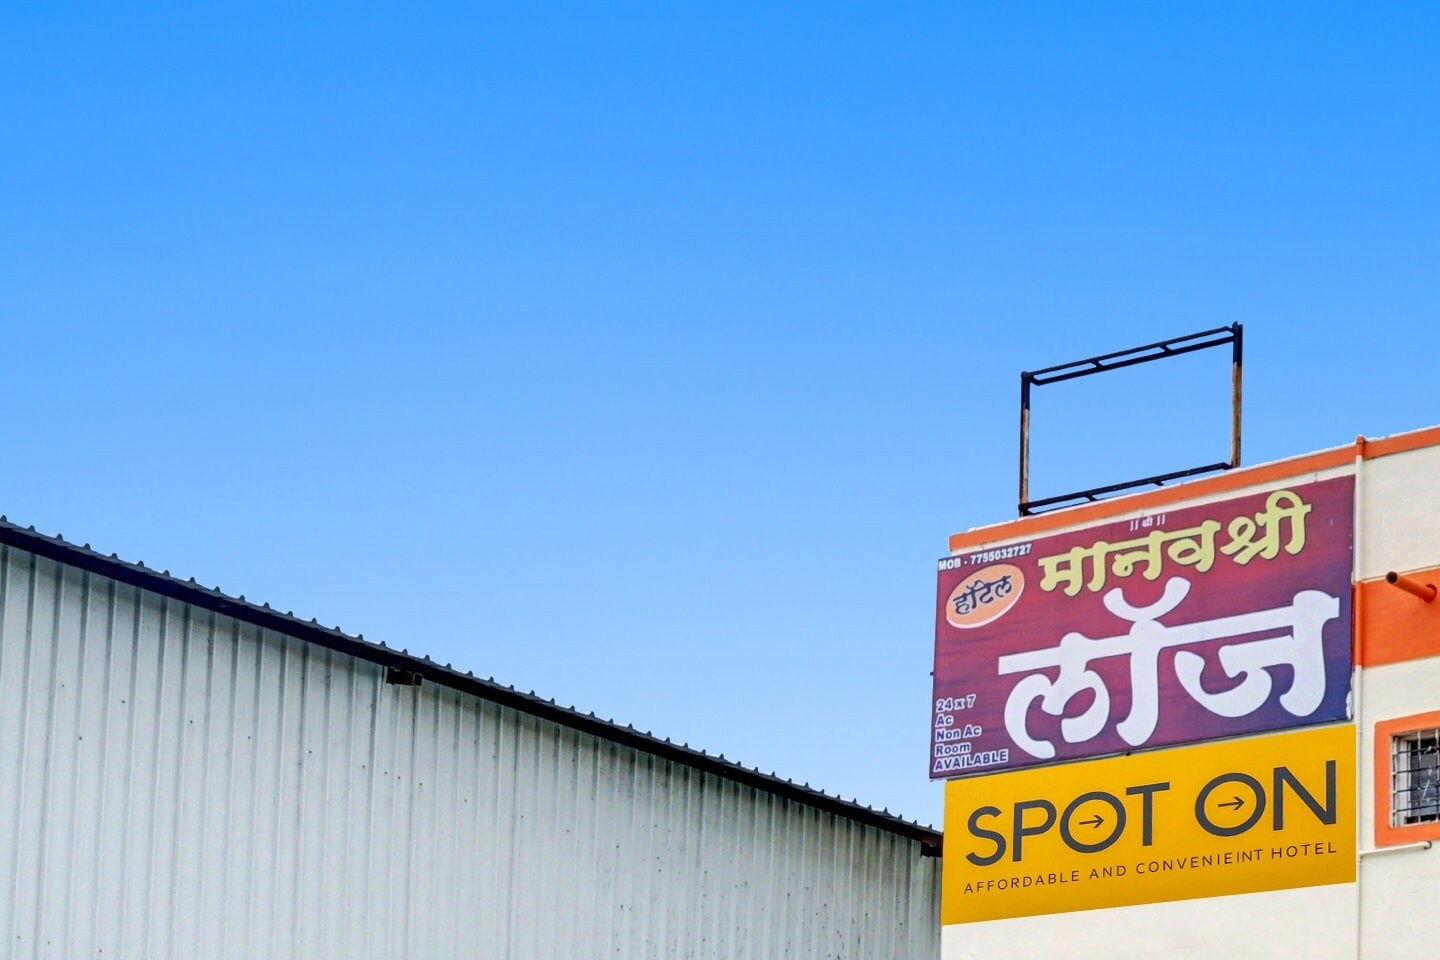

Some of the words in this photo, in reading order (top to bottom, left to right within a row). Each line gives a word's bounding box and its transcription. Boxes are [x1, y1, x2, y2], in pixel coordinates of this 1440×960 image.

[1038, 489, 1312, 596] मानवश्री
[938, 558, 961, 571] MOB
[970, 543, 1033, 565] 7755032727
[998, 577, 1340, 759] लॉज
[935, 713, 953, 727] Ac
[935, 728, 960, 742] Non
[963, 724, 981, 738] Ac
[933, 749, 1008, 772] AVAILABLE
[935, 742, 971, 757] Room
[965, 781, 1170, 867] SPOT
[1194, 760, 1337, 837] ON
[964, 870, 1080, 894] AFFORDABLE
[1089, 865, 1127, 880] AND
[1136, 849, 1264, 874] CONVENIEINT
[1271, 842, 1337, 860] HOTEL
